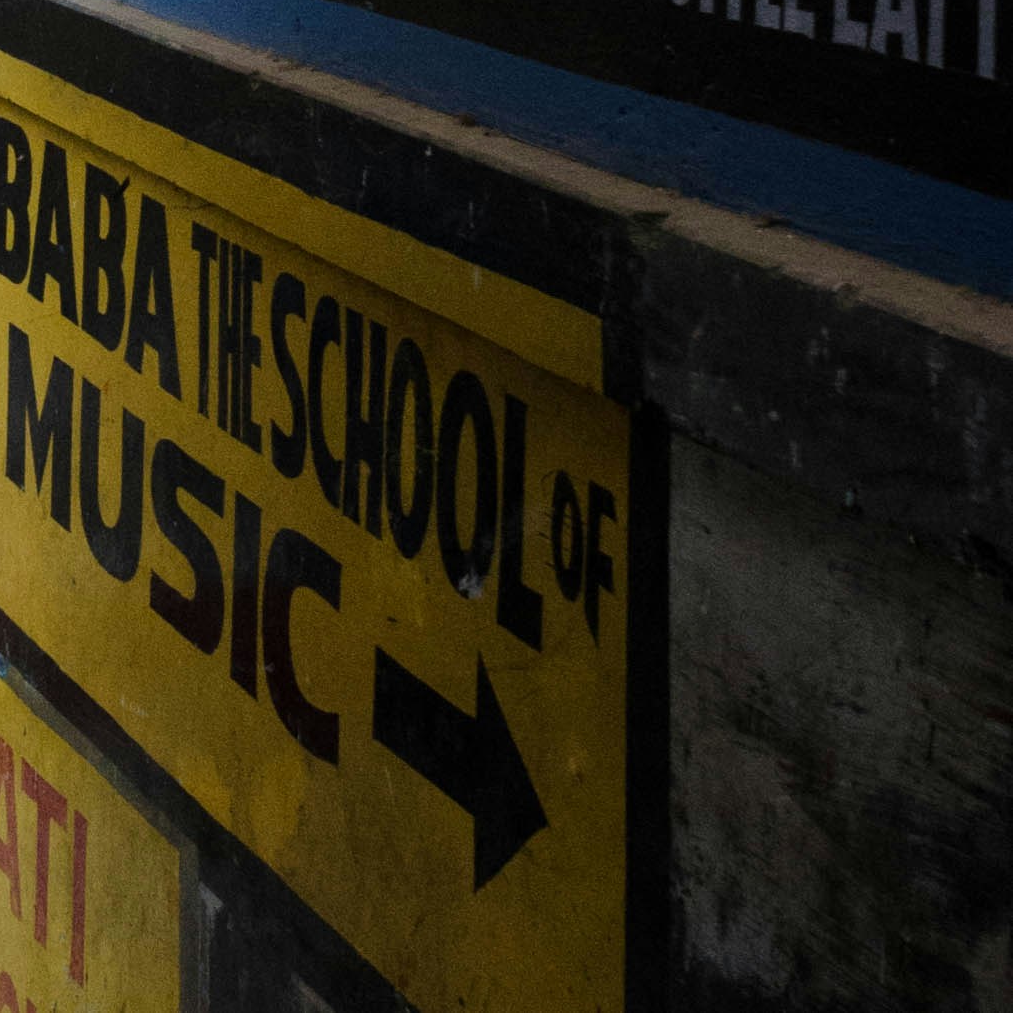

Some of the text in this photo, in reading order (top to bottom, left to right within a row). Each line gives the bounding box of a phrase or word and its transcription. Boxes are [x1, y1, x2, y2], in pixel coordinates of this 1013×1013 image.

[4, 321, 342, 767] MUSIC
[190, 226, 262, 456] THE
[270, 272, 544, 652] SCHOOL
[551, 469, 618, 647] OF
